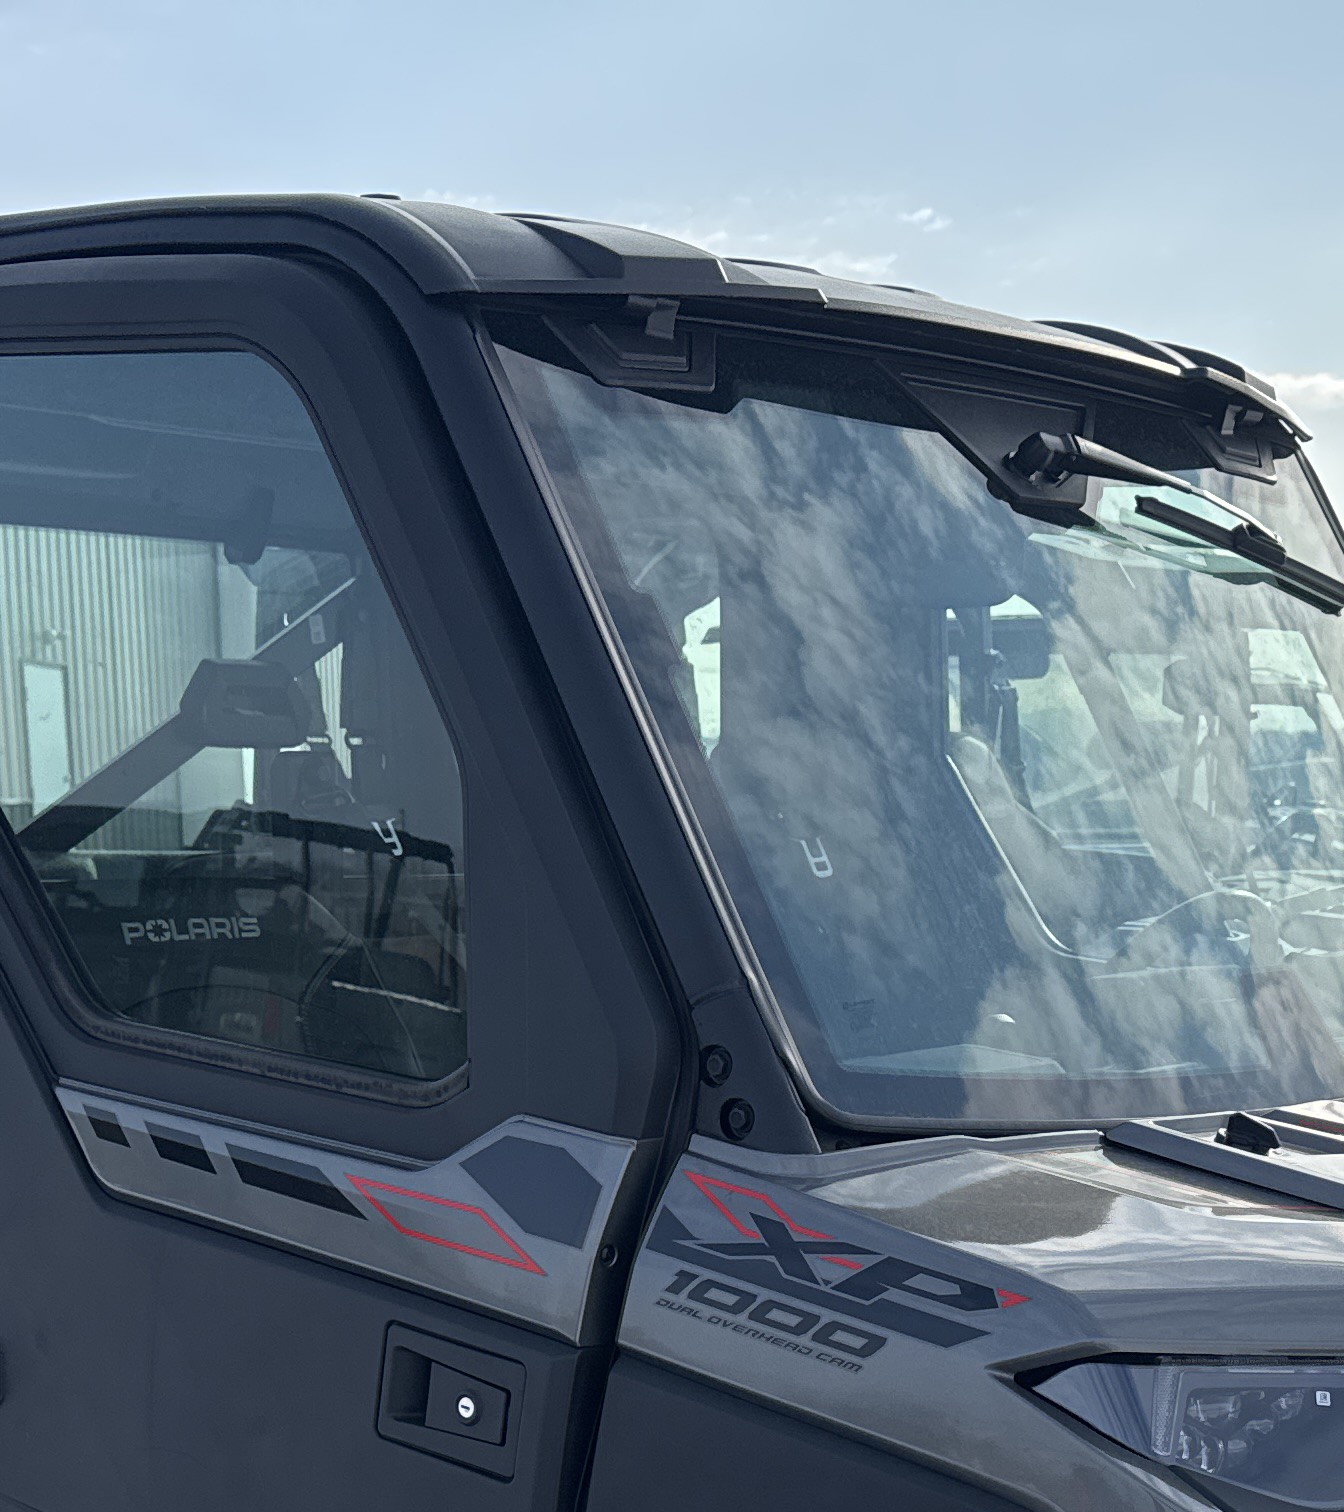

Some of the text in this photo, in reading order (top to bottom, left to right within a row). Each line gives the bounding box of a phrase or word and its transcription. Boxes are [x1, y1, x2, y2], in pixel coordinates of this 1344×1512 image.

[120, 916, 262, 946] POLARIS
[694, 1211, 999, 1311] XP
[656, 1298, 864, 1374] DUAL OVERHEAD CAM
[663, 1269, 888, 1358] 1000
